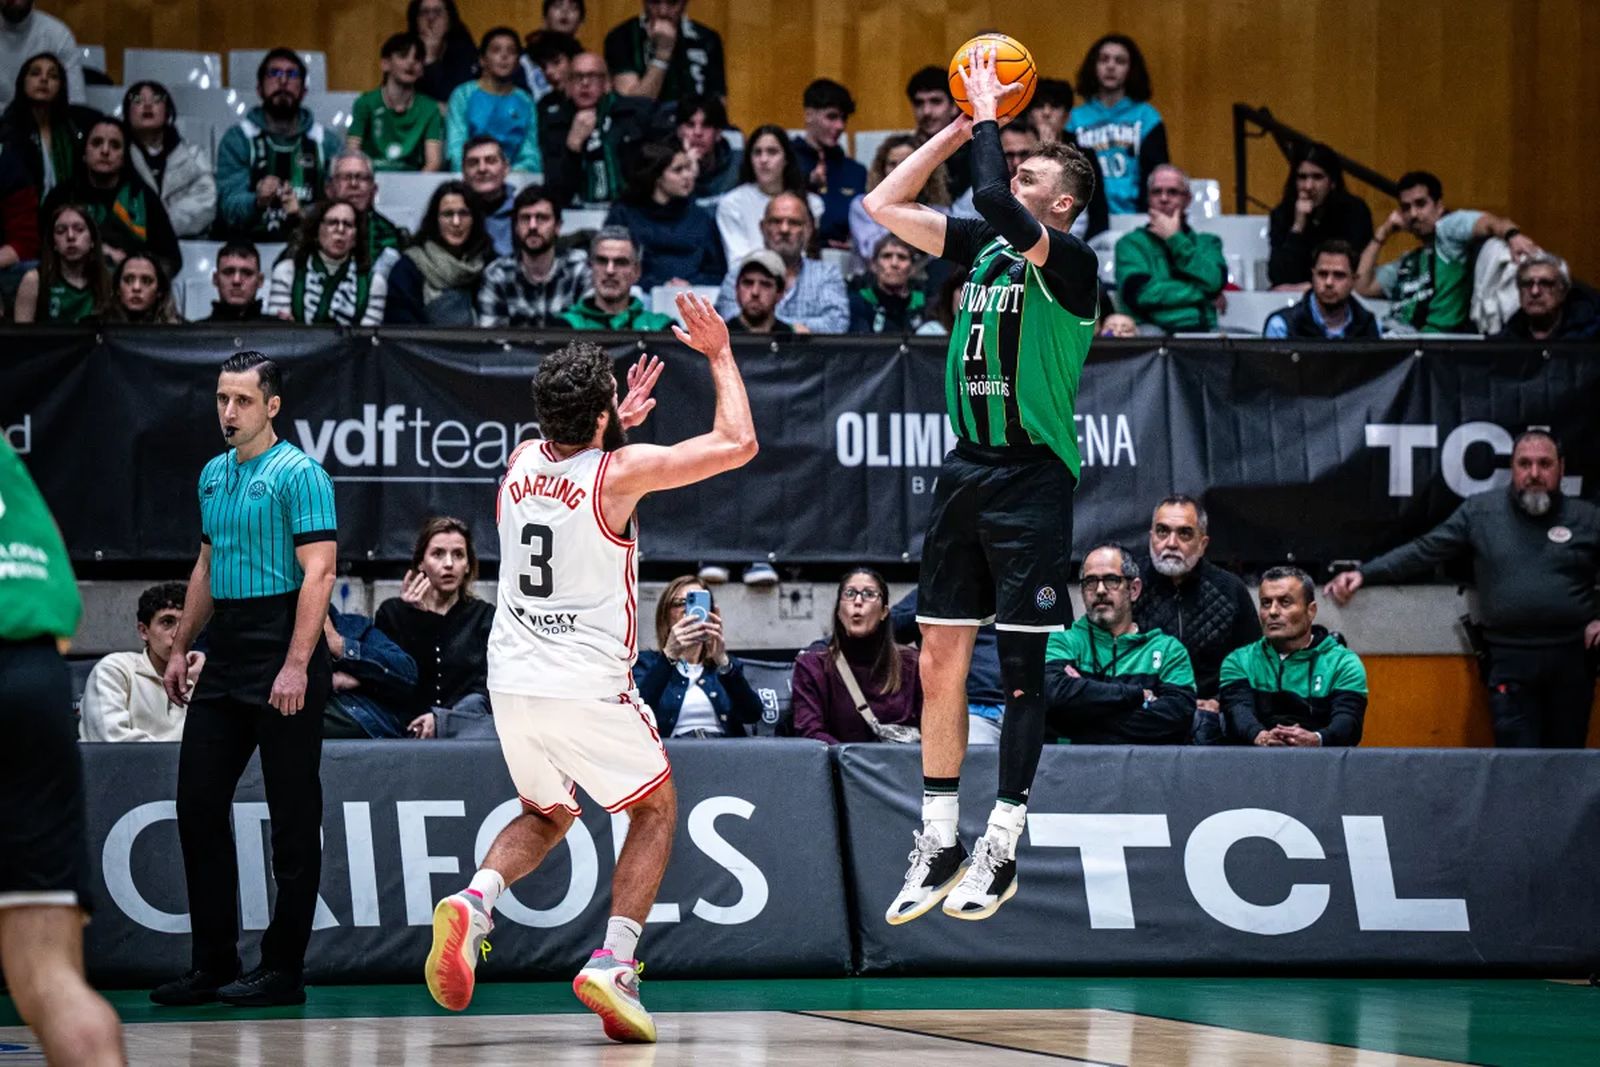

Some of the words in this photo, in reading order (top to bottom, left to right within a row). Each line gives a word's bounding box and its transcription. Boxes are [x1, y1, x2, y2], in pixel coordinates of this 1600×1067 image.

[1365, 421, 1583, 499] TC
[508, 474, 586, 511] DARLING
[519, 522, 554, 599] 3
[528, 613, 578, 627] VICKY
[535, 625, 576, 636] OODS
[1028, 807, 1470, 936] TCL
